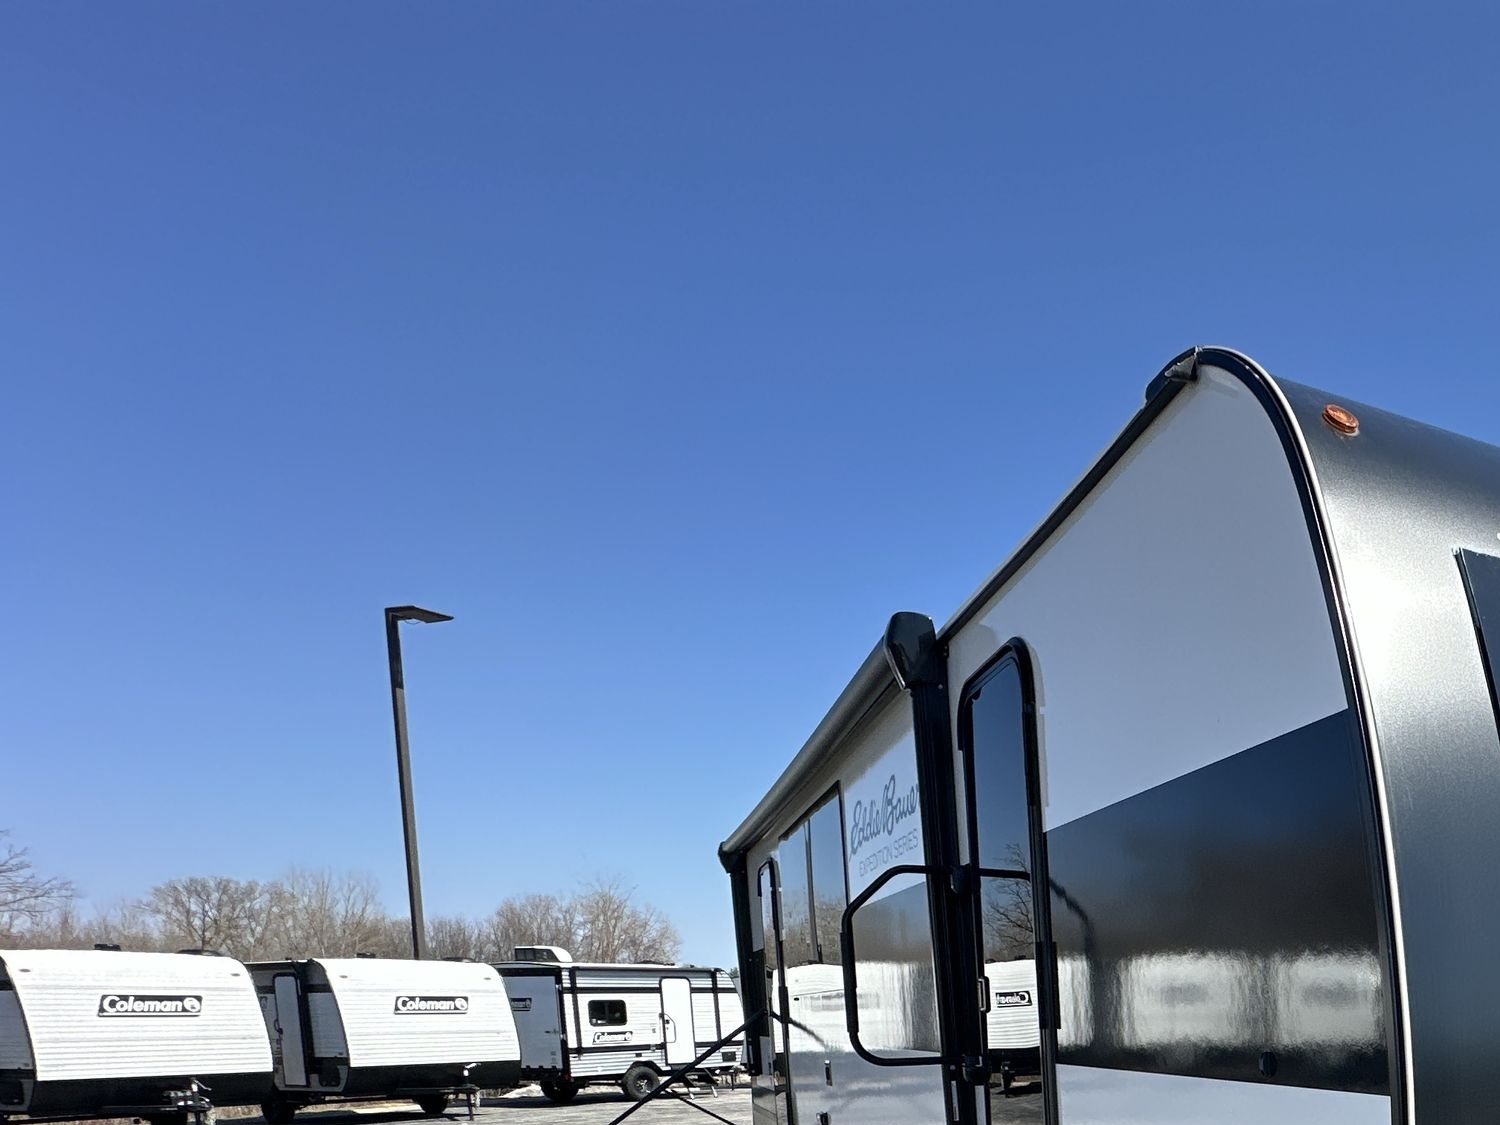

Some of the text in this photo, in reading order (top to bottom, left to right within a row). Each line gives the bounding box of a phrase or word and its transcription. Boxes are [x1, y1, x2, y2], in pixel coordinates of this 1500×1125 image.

[849, 800, 881, 862] Eddie
[893, 828, 919, 858] SERIES
[103, 995, 183, 1013] Coleman
[397, 997, 455, 1011] Coleman
